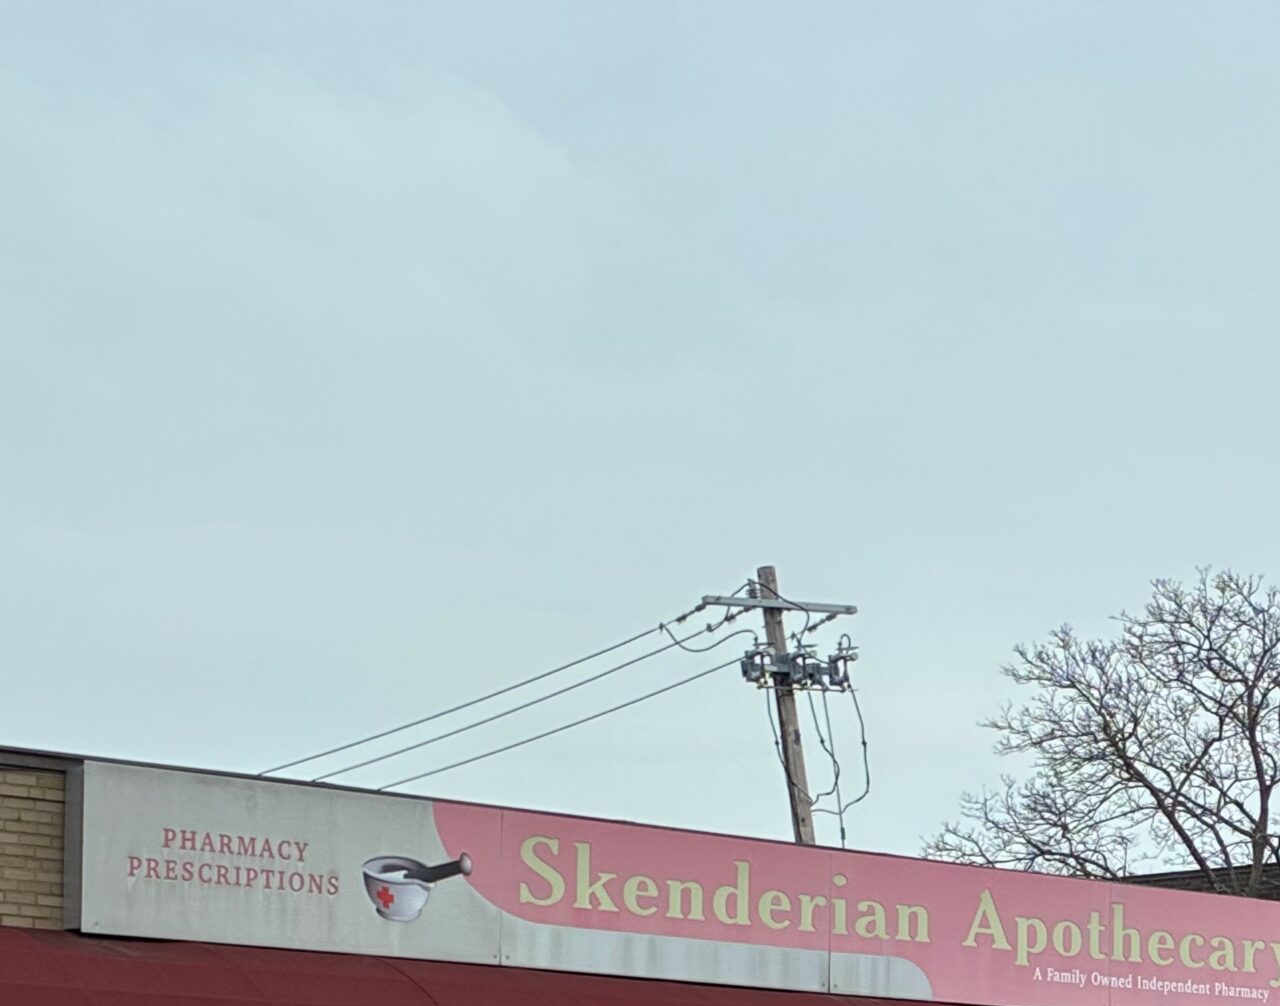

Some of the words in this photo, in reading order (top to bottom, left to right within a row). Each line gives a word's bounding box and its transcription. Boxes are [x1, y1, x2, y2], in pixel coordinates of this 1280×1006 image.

[161, 828, 309, 863] PHARMACY
[127, 856, 340, 896] PRESCRIPTIONS
[518, 834, 931, 944] Skenderian
[1033, 967, 1043, 981] A
[1047, 967, 1087, 988] Family
[1091, 971, 1132, 990] Owned
[1137, 977, 1210, 996] Independent
[1215, 982, 1270, 1003] Pharmacy
